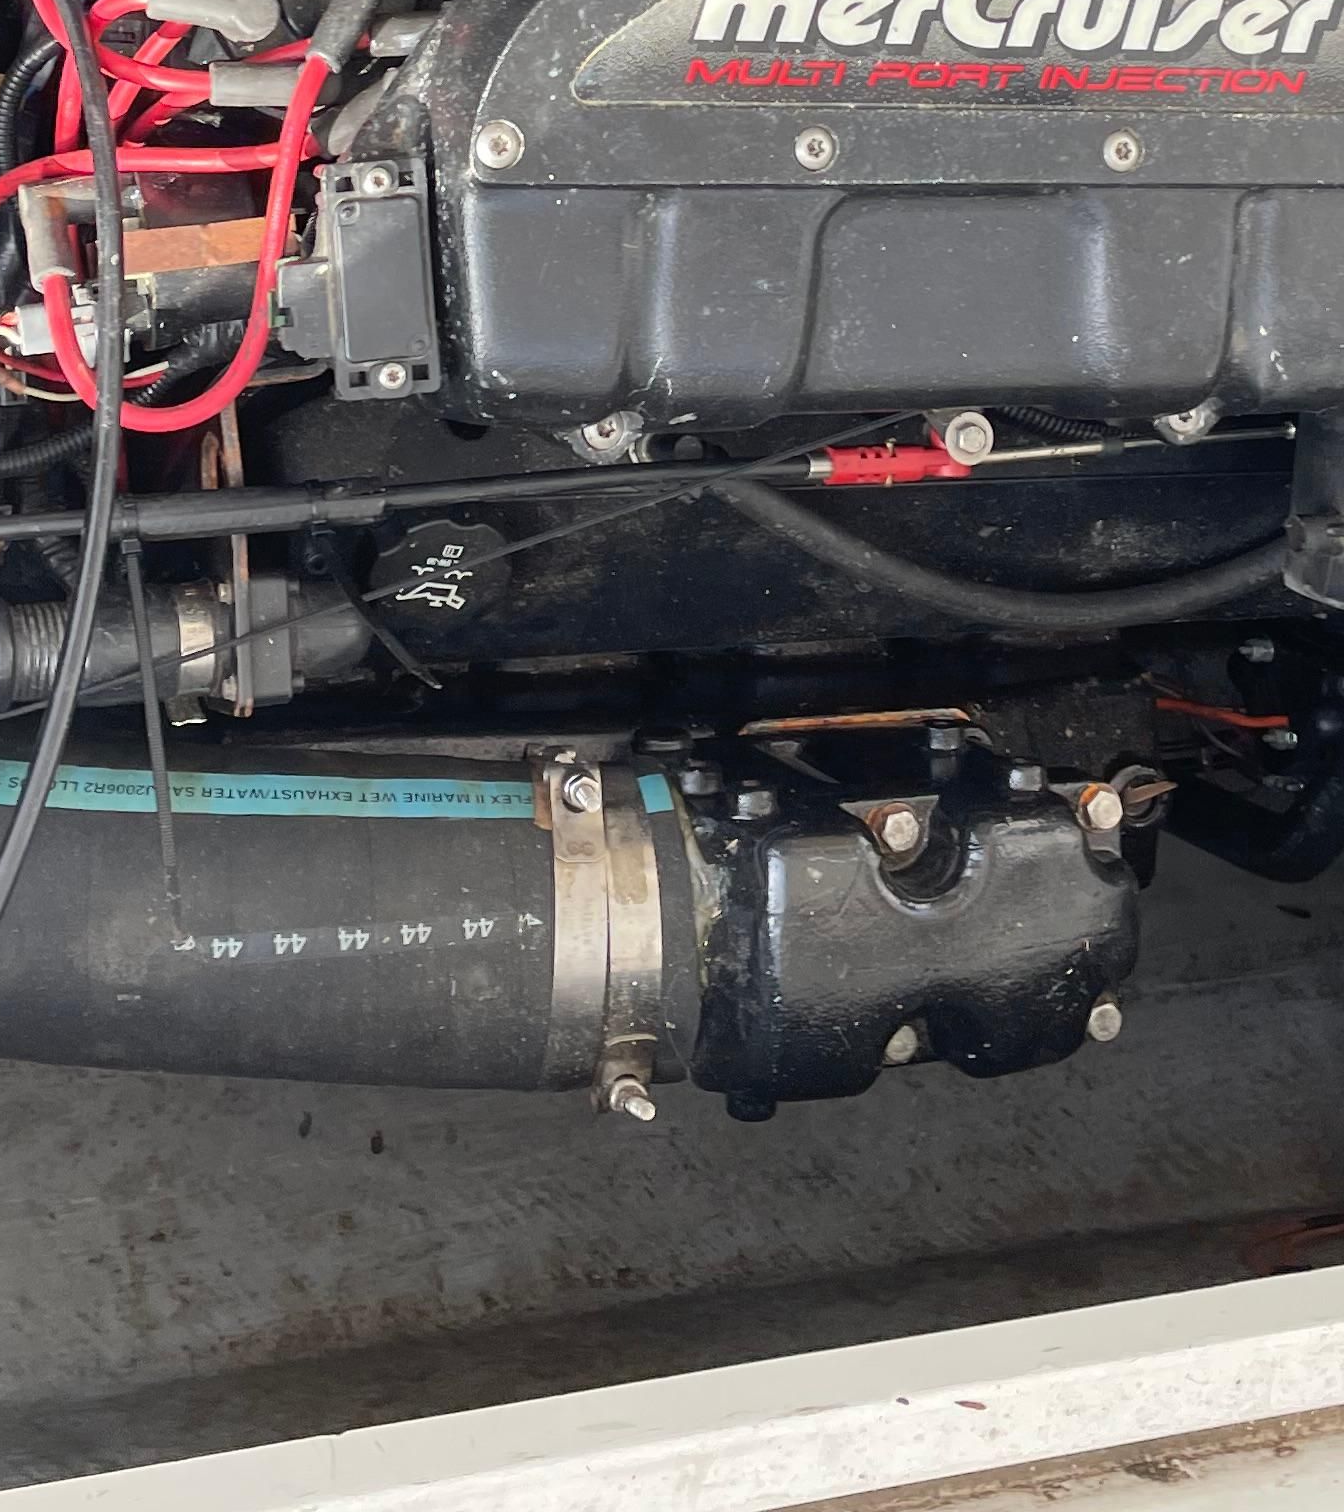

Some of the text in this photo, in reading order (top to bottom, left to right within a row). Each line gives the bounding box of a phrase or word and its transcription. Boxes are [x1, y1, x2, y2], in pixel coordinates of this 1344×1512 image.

[684, 58, 1309, 96] MULTI PORT INJECTION
[200, 786, 353, 802] EXHAUST/WATER
[357, 791, 397, 804] WET
[402, 791, 471, 804] MARINE
[337, 926, 370, 951] 44
[400, 922, 433, 946] 44
[462, 917, 495, 940] 44
[210, 937, 244, 959] 44
[273, 933, 307, 955] 44
